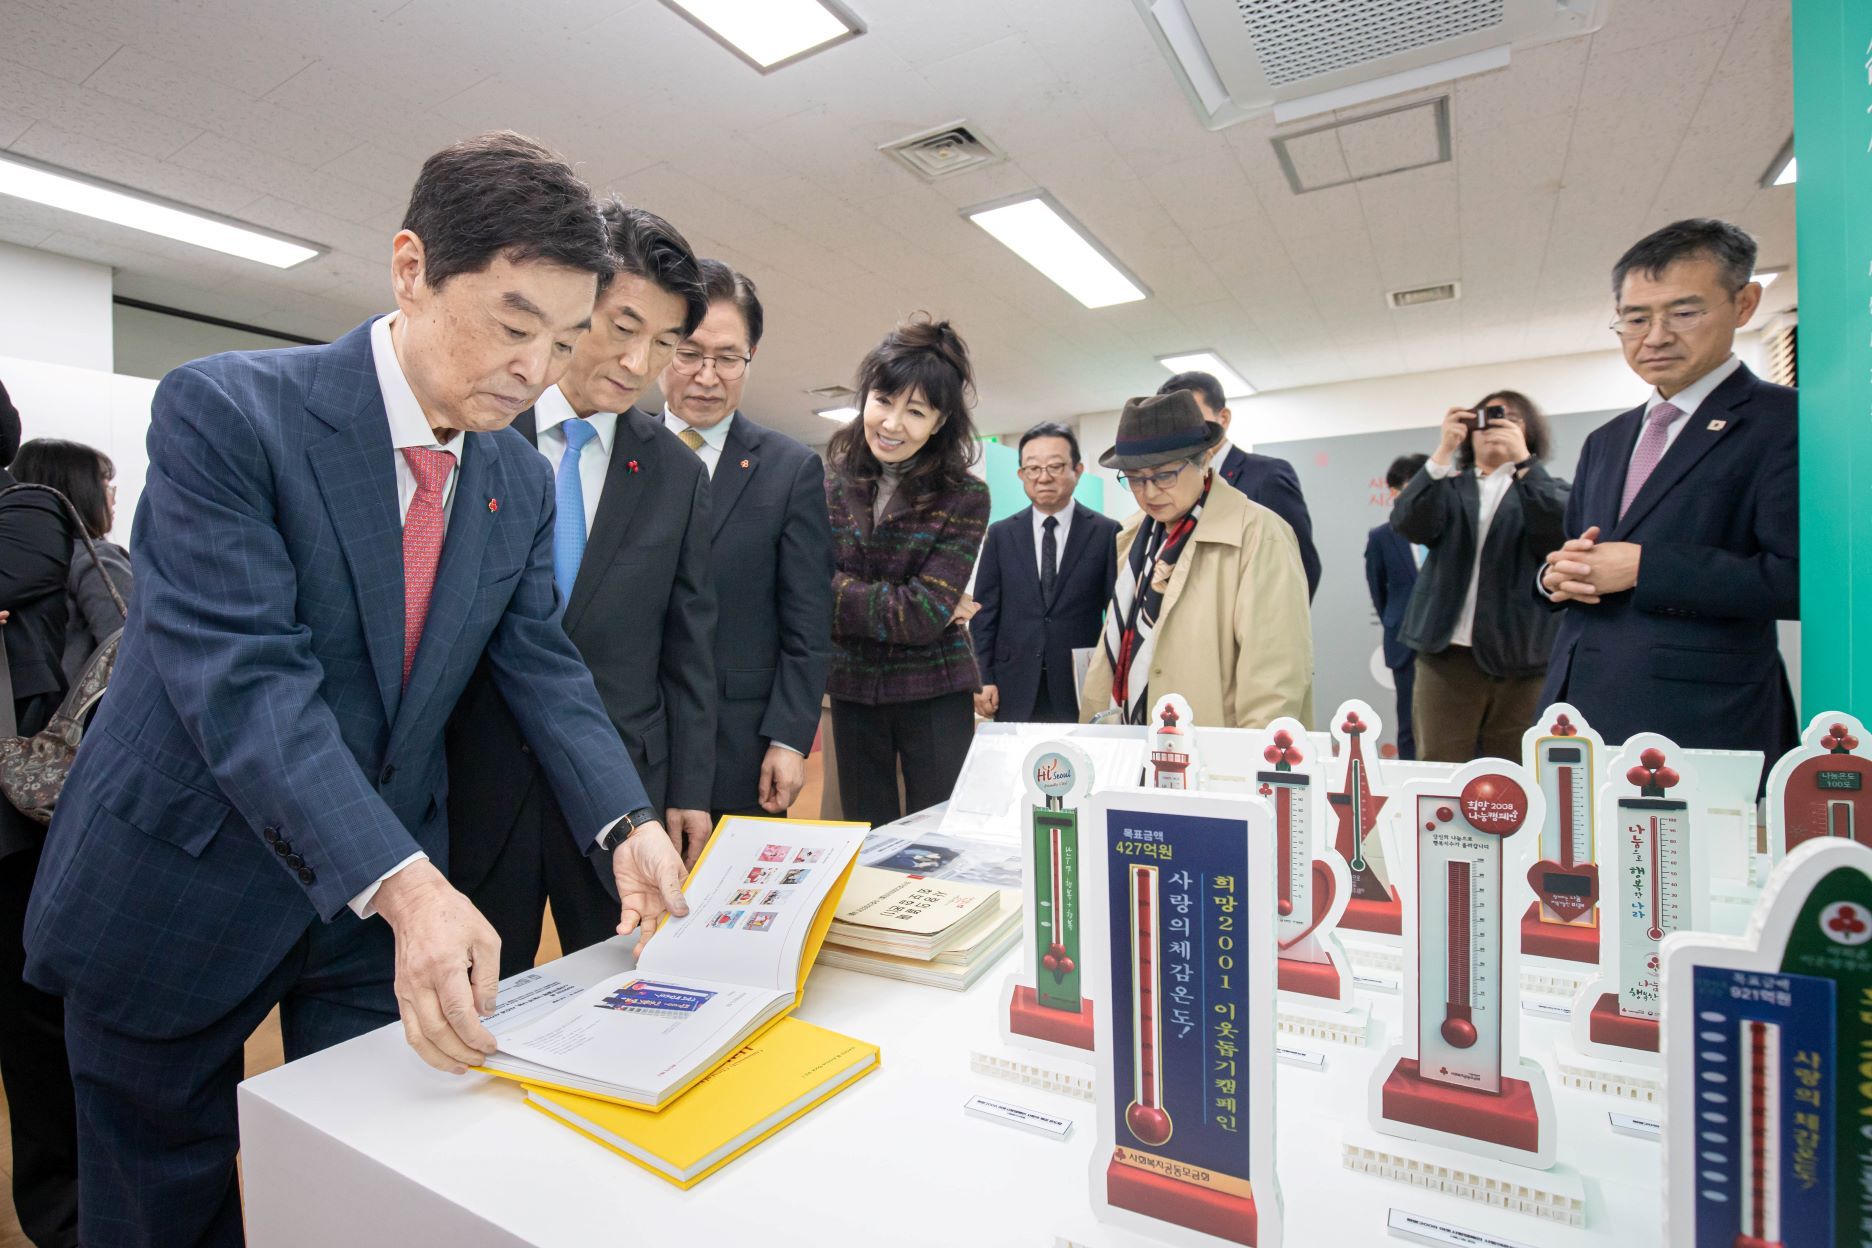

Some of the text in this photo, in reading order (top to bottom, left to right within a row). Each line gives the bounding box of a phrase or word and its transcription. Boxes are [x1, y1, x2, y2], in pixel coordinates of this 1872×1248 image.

[1037, 765, 1071, 782] Hi Seoul
[1467, 800, 1490, 811] 희망
[1123, 828, 1164, 842] 목표금액
[1115, 841, 1173, 860] 427억원
[1628, 825, 1645, 918] 나눔으로 행복한 나라
[1129, 1152, 1210, 1182] 사회복지공동모금회
